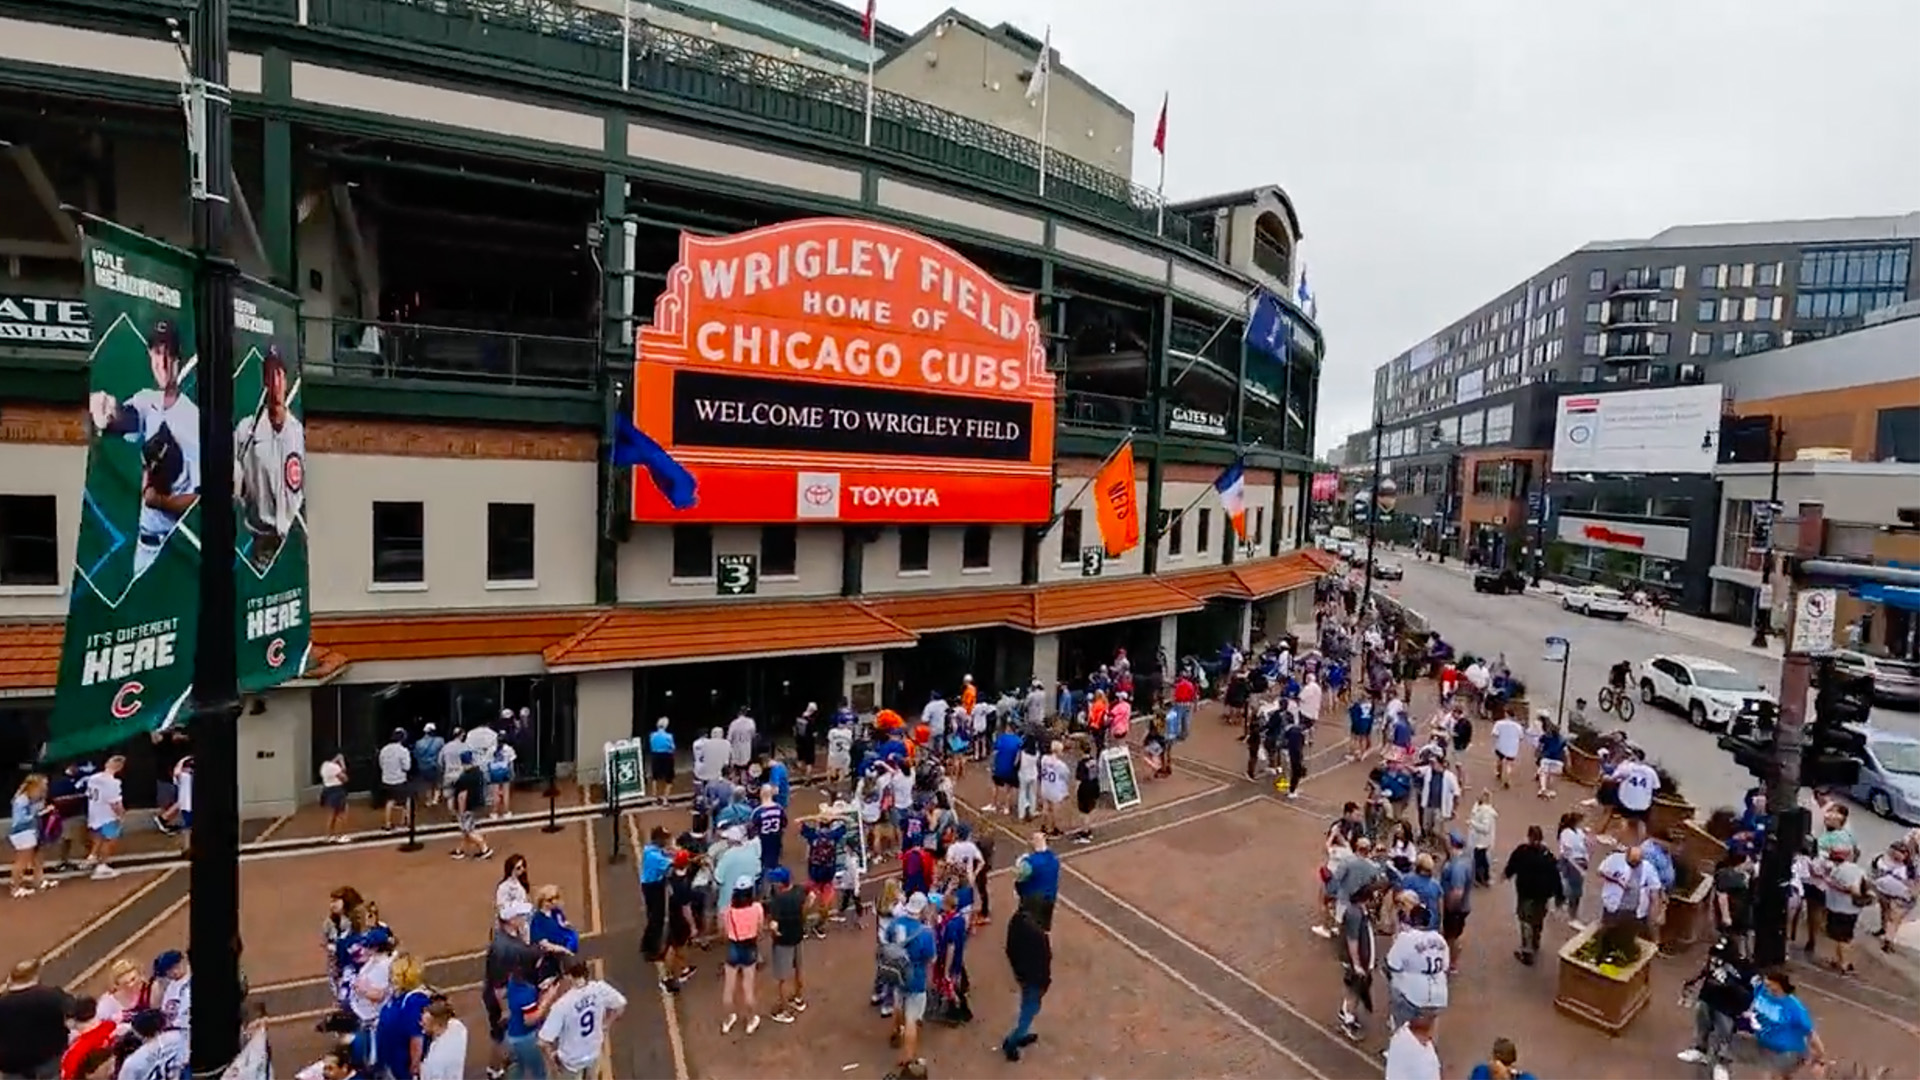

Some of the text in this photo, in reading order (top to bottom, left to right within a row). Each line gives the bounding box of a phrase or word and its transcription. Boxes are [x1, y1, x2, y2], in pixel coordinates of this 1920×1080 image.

[699, 237, 1022, 341] WRIGLEY FIELD
[803, 290, 948, 332] HOME OF
[695, 320, 1022, 391] CHICAGO CUBS
[695, 399, 1020, 441] WELCOME TO WRIGLEY FIELD
[848, 485, 940, 507] TOYOTA
[723, 565, 750, 587] 3
[87, 631, 113, 649] IT'S
[247, 599, 303, 640] HERE
[81, 632, 177, 686] HERE
[760, 818, 781, 834] 23
[580, 1010, 595, 1037] 9
